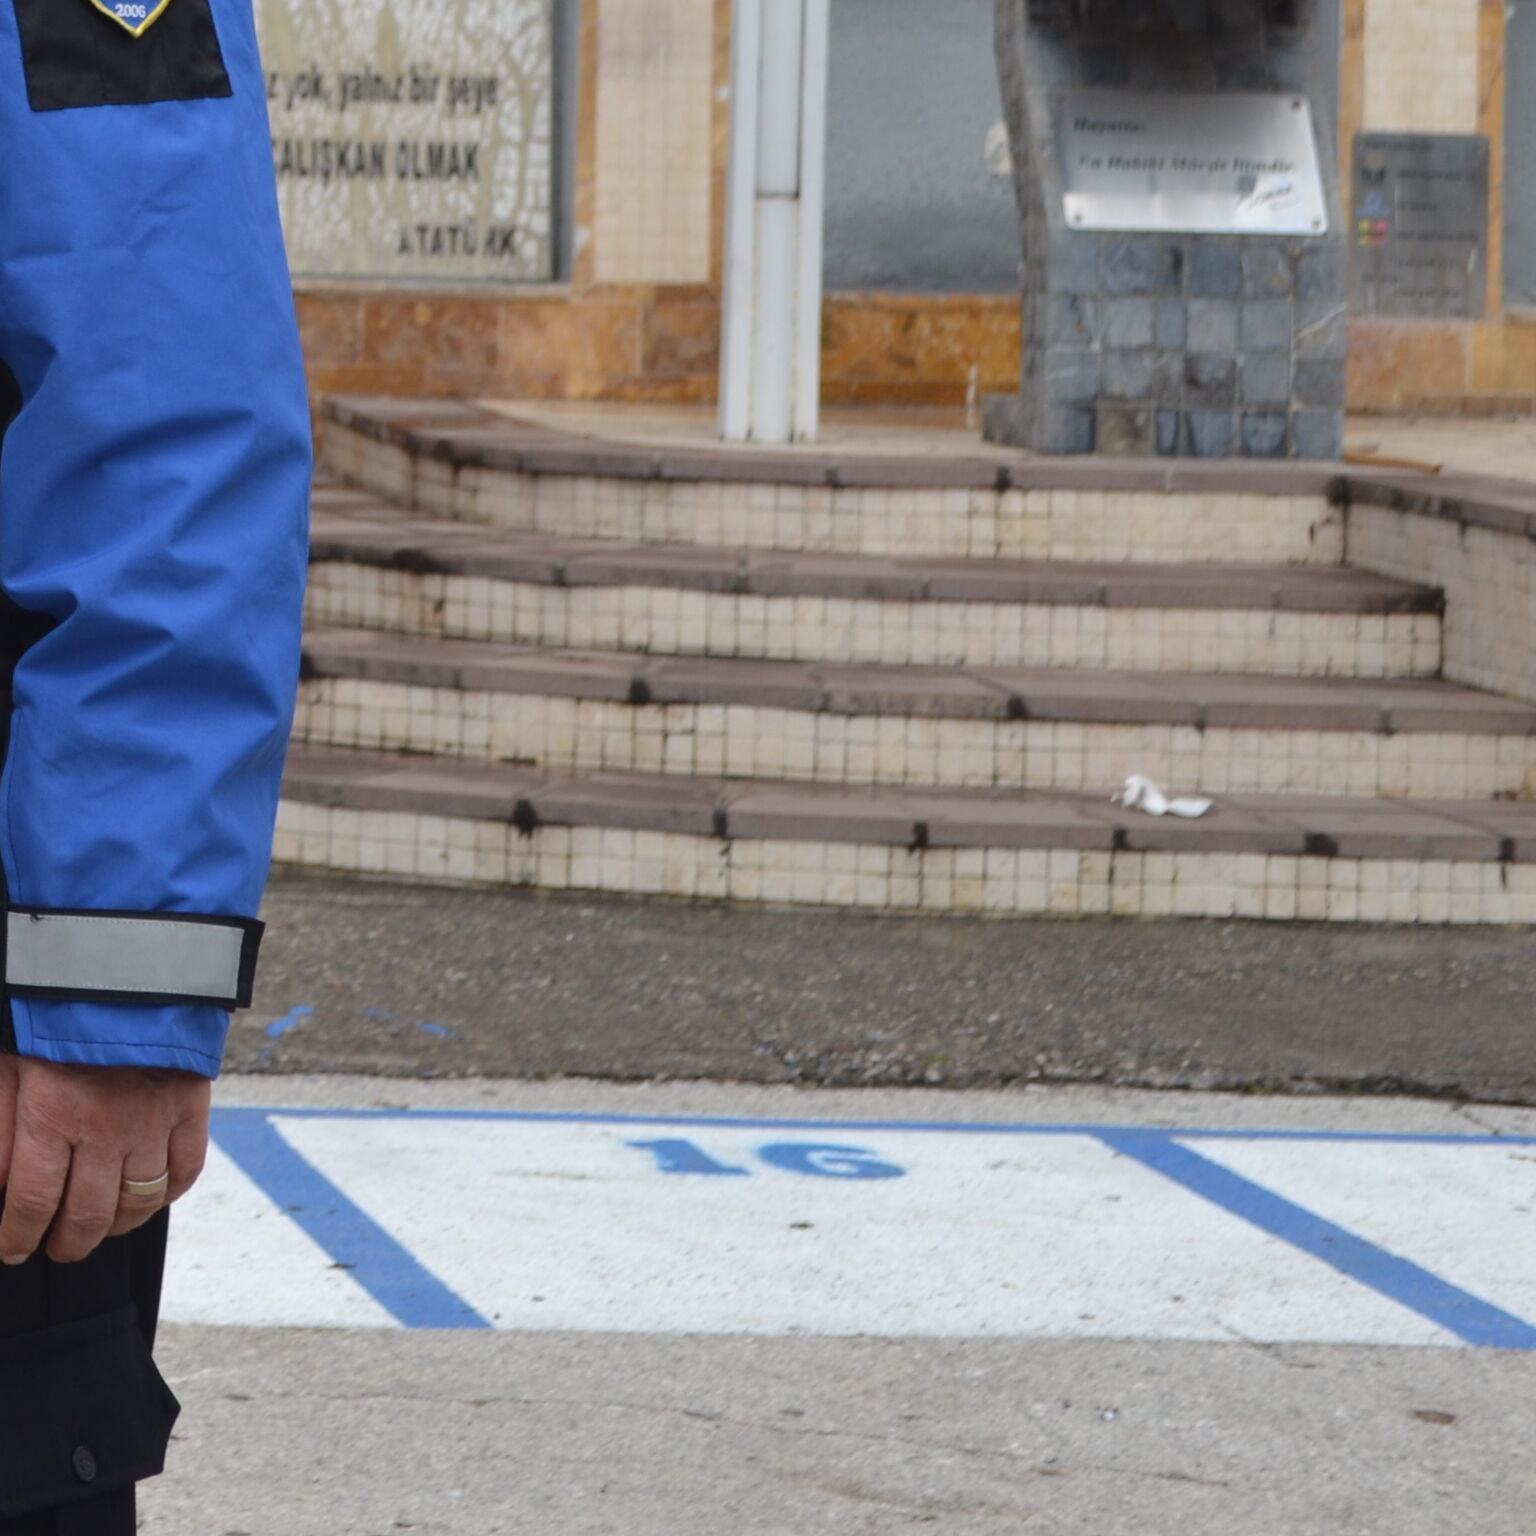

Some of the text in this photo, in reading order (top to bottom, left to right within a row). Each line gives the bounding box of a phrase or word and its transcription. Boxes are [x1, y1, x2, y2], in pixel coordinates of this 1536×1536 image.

[114, 3, 147, 18] 2006
[409, 64, 439, 103] bir
[395, 140, 479, 180] OLMAK
[397, 218, 516, 257] ATATÜRK
[624, 1138, 908, 1180] 16
